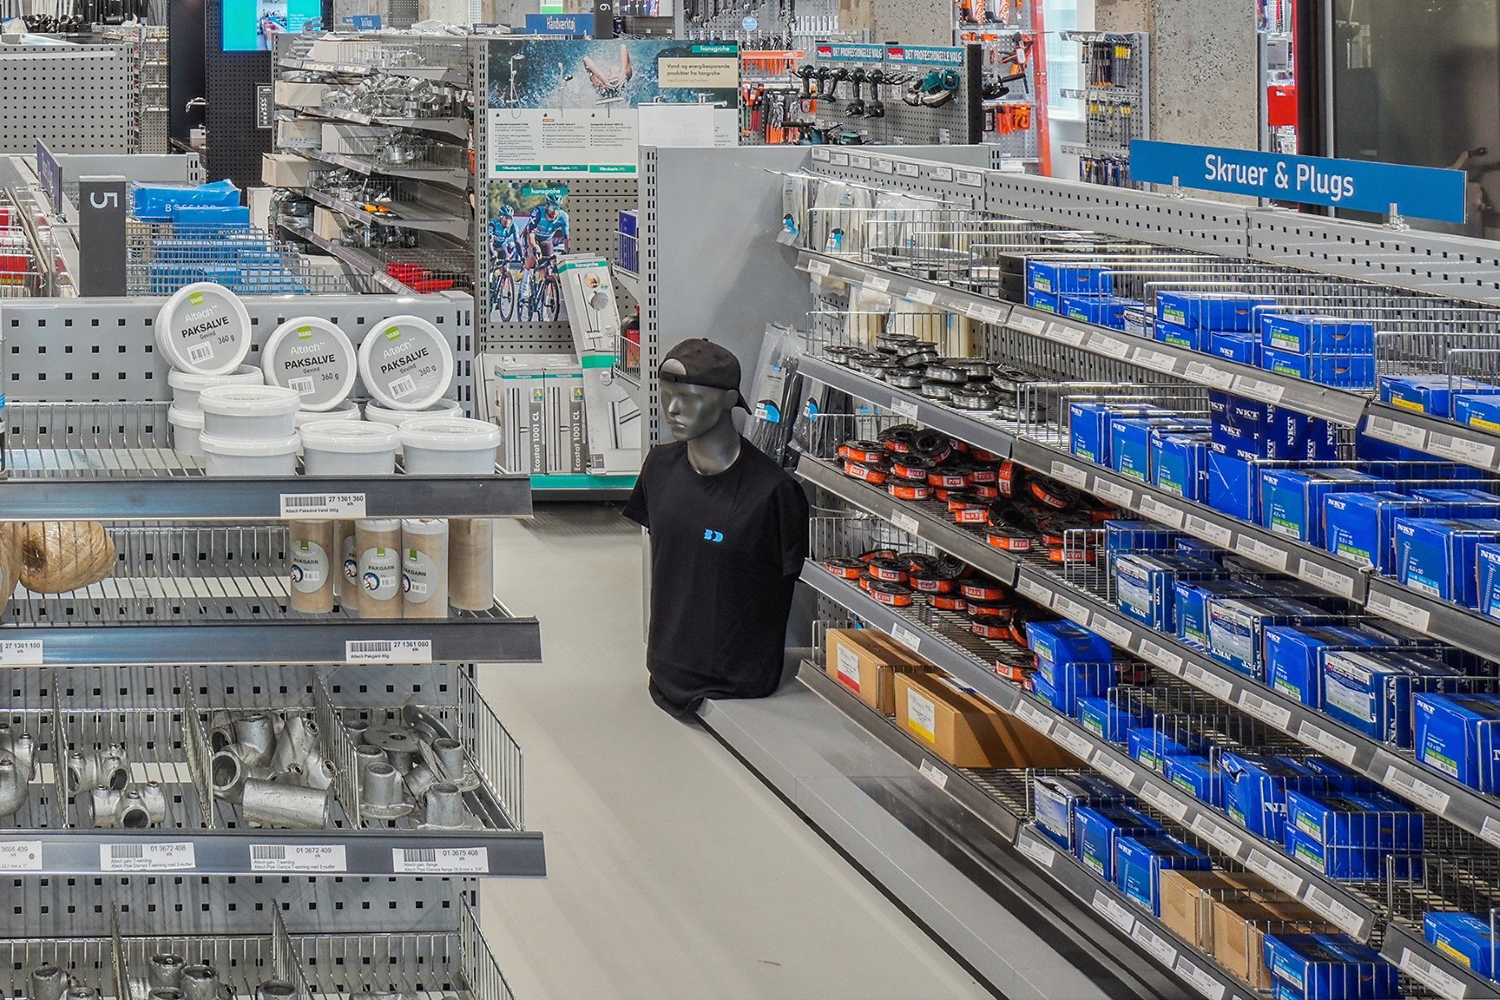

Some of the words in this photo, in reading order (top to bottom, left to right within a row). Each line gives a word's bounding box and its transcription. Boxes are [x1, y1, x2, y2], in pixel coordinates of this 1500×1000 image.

[700, 43, 730, 53] hansgrohe
[1204, 153, 1269, 187] Skruer
[1274, 161, 1289, 190] &
[1296, 163, 1355, 202] Plugs
[530, 188, 561, 197] hansgrohe
[90, 192, 119, 209] 5
[185, 307, 214, 323] Altech
[181, 316, 230, 339] PAKSALVE
[218, 334, 230, 344] 360
[290, 344, 321, 356] Altech
[383, 340, 412, 359] Altech
[284, 354, 336, 370] PAKSALVE
[380, 347, 429, 374] PAKSALVE
[322, 372, 333, 381] 360
[418, 366, 431, 376] 360
[534, 411, 540, 422] CL
[574, 410, 580, 421] CL
[1236, 407, 1259, 419] NKT
[1112, 423, 1127, 432] NKT
[1220, 423, 1242, 435] NKT
[1262, 475, 1279, 486] NKT
[1327, 499, 1346, 511] NKT
[1397, 523, 1415, 536] NKT
[293, 557, 319, 565] PAKGARN
[882, 571, 895, 579] MAX
[1266, 632, 1281, 643] NKT
[1417, 700, 1435, 714] NKT
